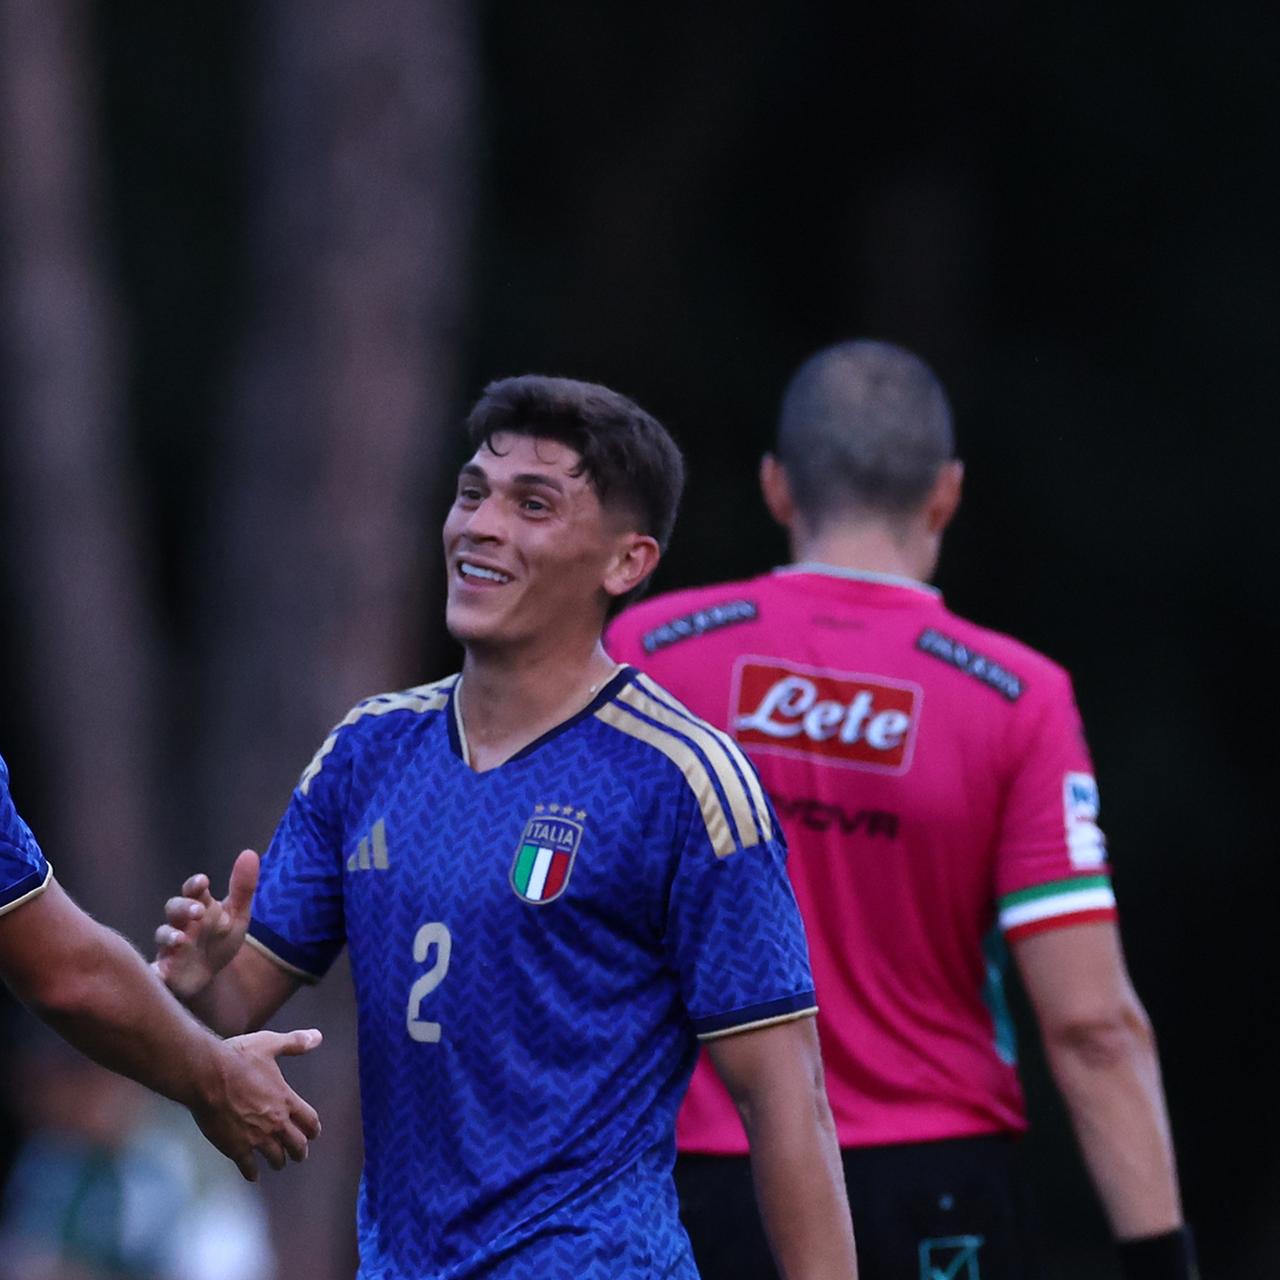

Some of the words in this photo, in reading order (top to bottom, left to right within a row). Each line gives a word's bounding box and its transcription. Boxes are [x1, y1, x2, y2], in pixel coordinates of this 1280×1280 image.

[734, 675, 909, 750] Lete
[526, 822, 574, 846] ITALIA
[406, 922, 452, 1043] 2
